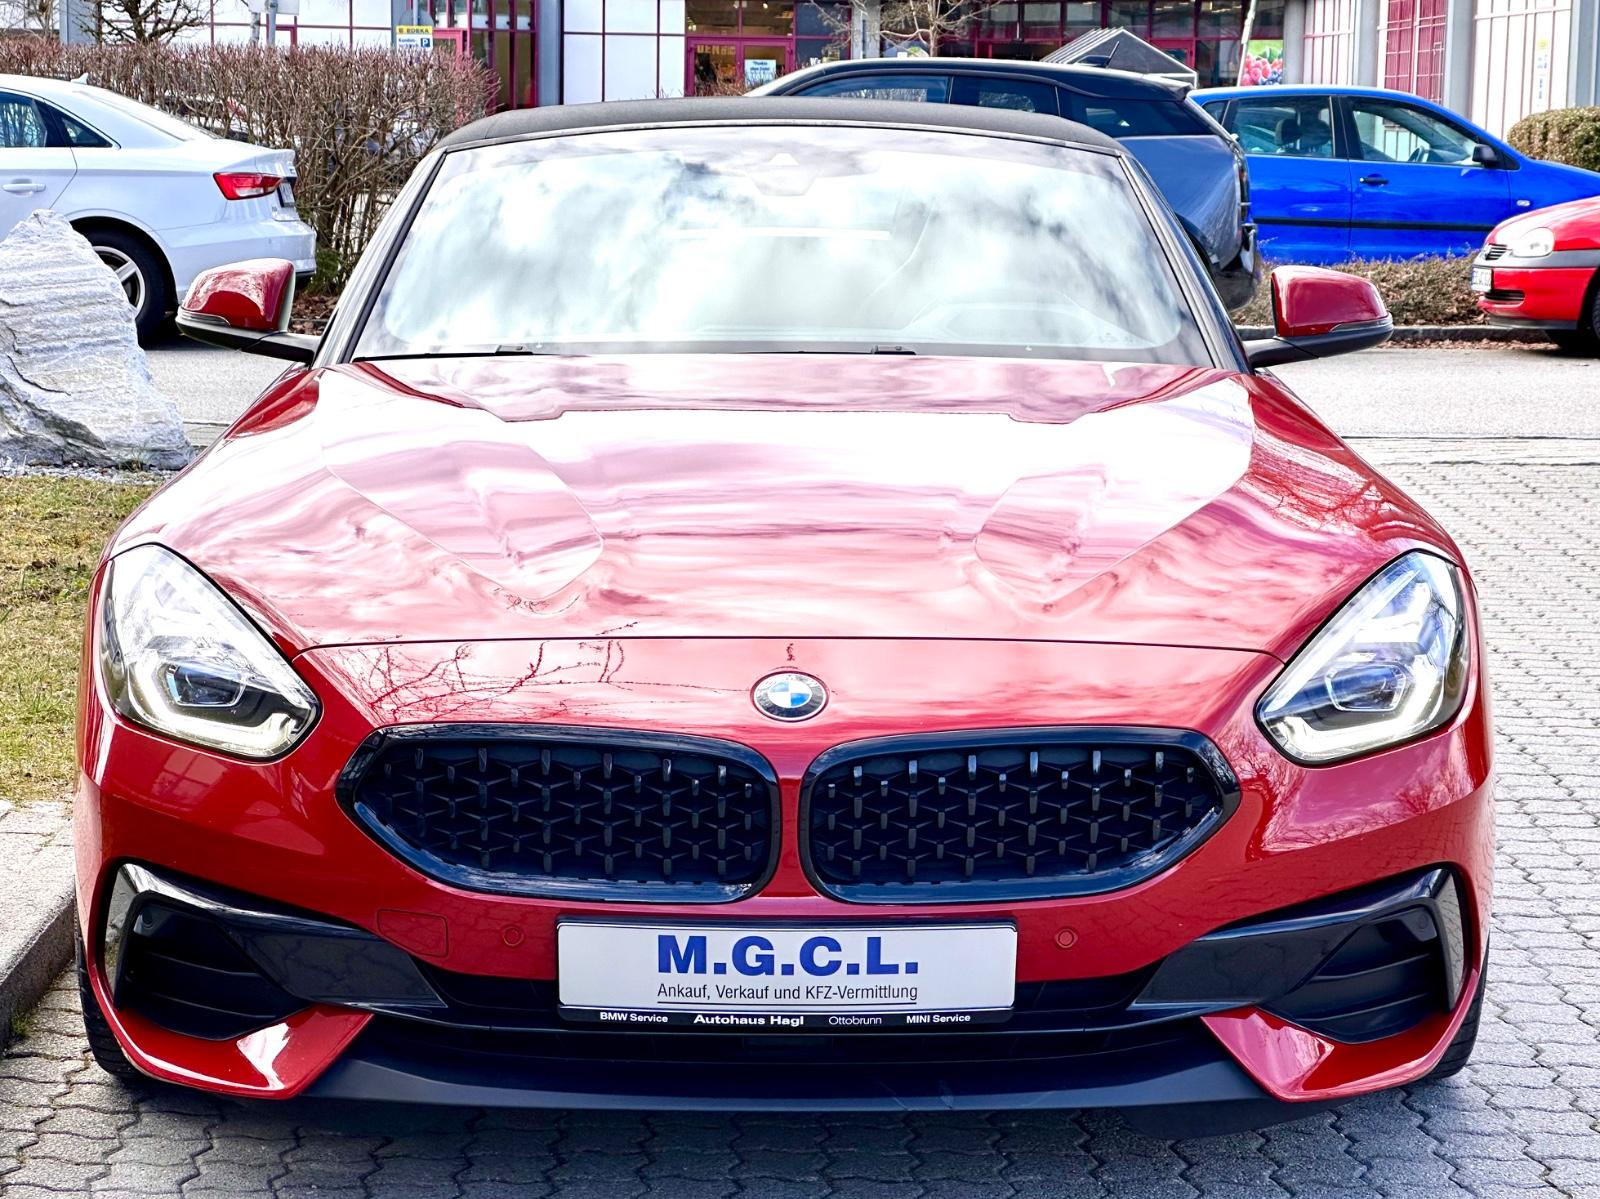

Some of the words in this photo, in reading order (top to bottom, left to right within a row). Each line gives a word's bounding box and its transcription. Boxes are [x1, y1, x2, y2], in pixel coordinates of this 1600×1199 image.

[658, 935, 918, 976] M.G.C.L.
[657, 984, 711, 1000] Ankauf,
[716, 985, 769, 999] Verkauf
[774, 986, 800, 999] und
[806, 985, 918, 1001] KFZ-Vermittlung
[600, 1012, 628, 1021] BMW
[630, 1014, 668, 1023] Service
[694, 1015, 765, 1025] Autohaus
[770, 1016, 804, 1027] Hagl
[828, 1016, 882, 1025] Ottobrunn
[906, 1015, 930, 1024] MINI
[933, 1014, 971, 1023] Service
